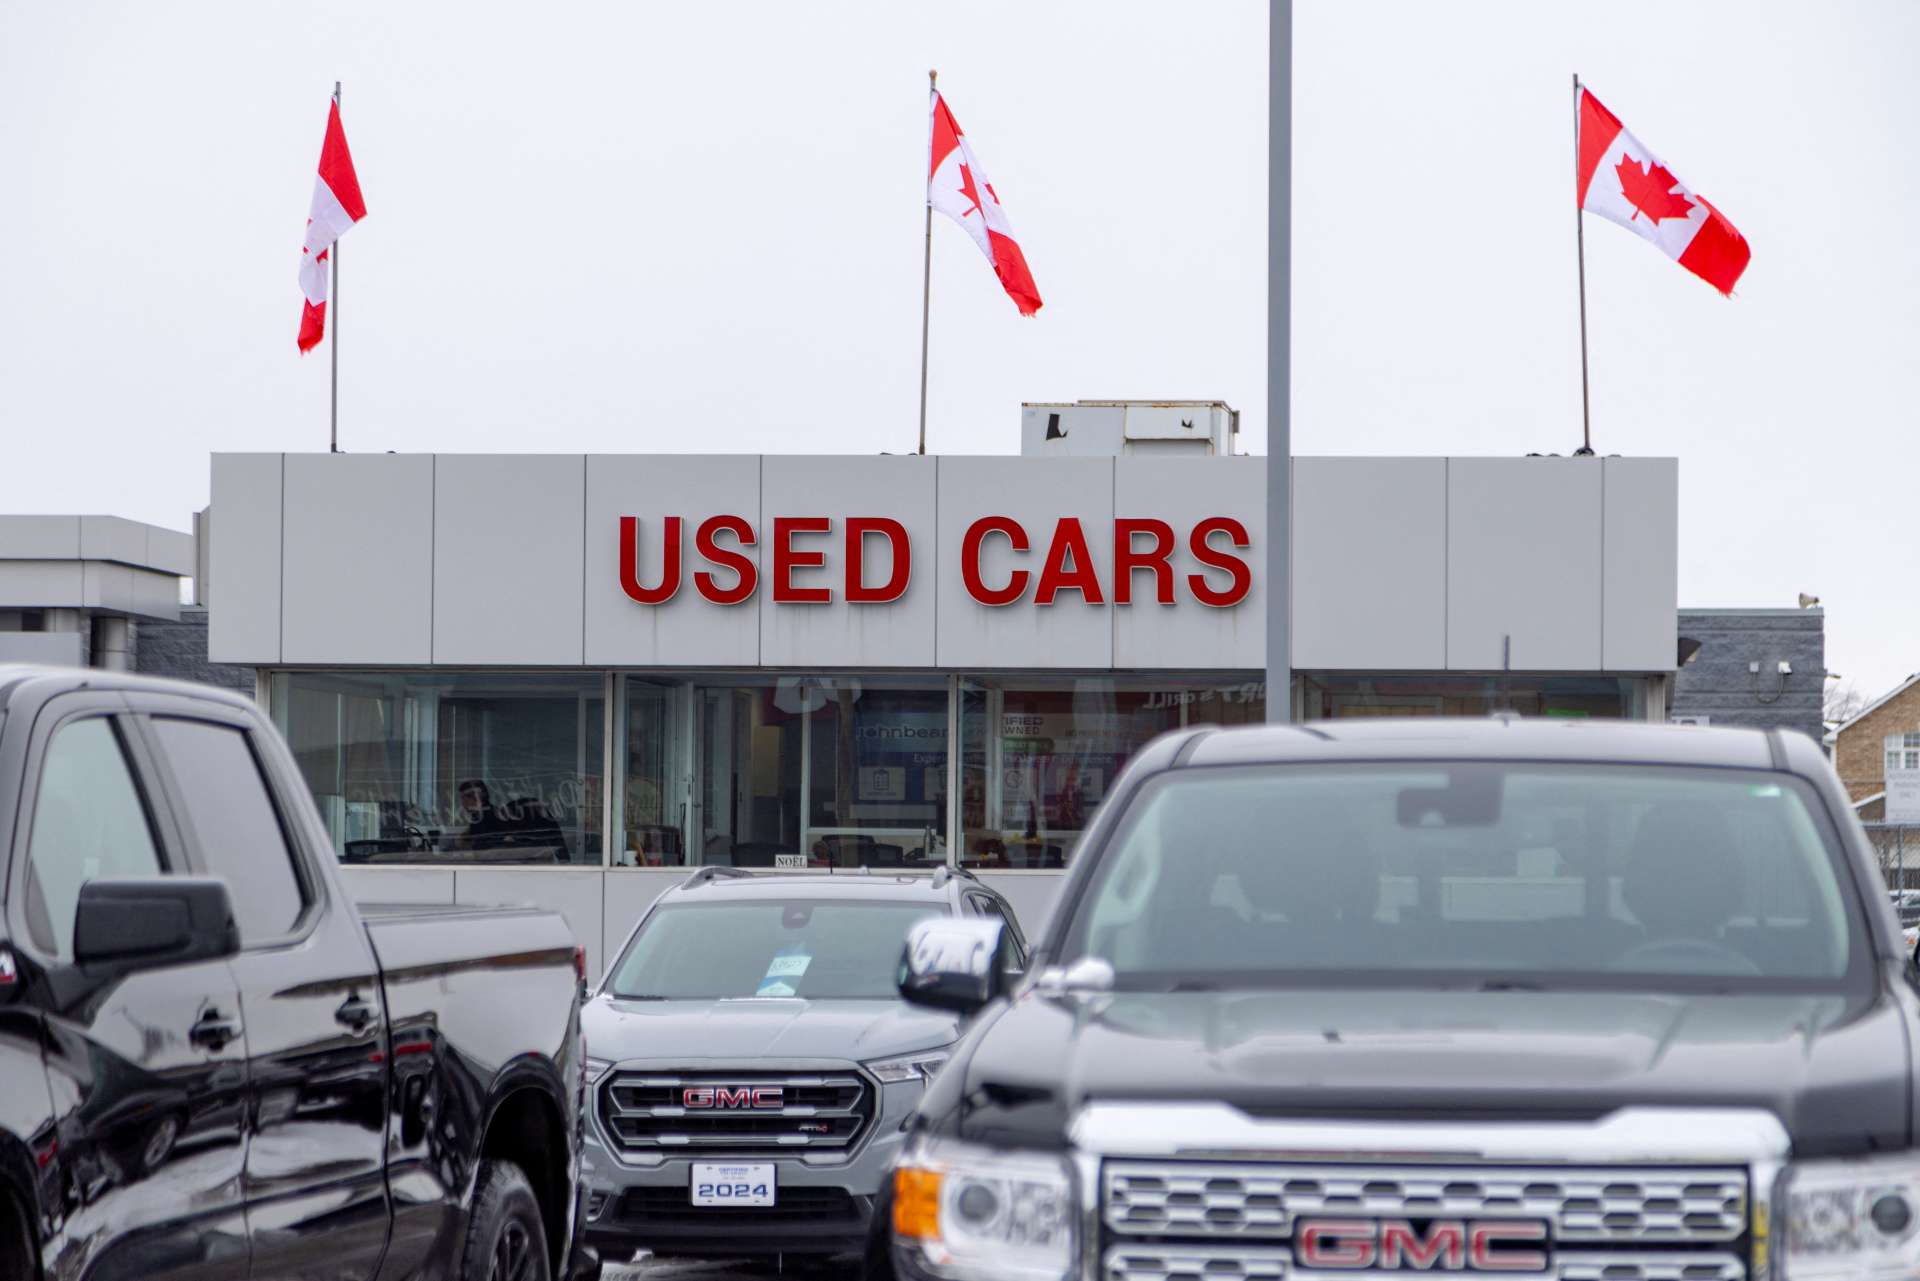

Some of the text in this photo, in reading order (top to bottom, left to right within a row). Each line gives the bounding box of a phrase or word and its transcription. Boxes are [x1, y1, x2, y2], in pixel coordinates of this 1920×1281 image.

[618, 515, 1252, 609] USED CARS
[683, 1087, 784, 1109] GMC
[698, 1183, 768, 1198] 2024
[1299, 1219, 1549, 1271] GMC
